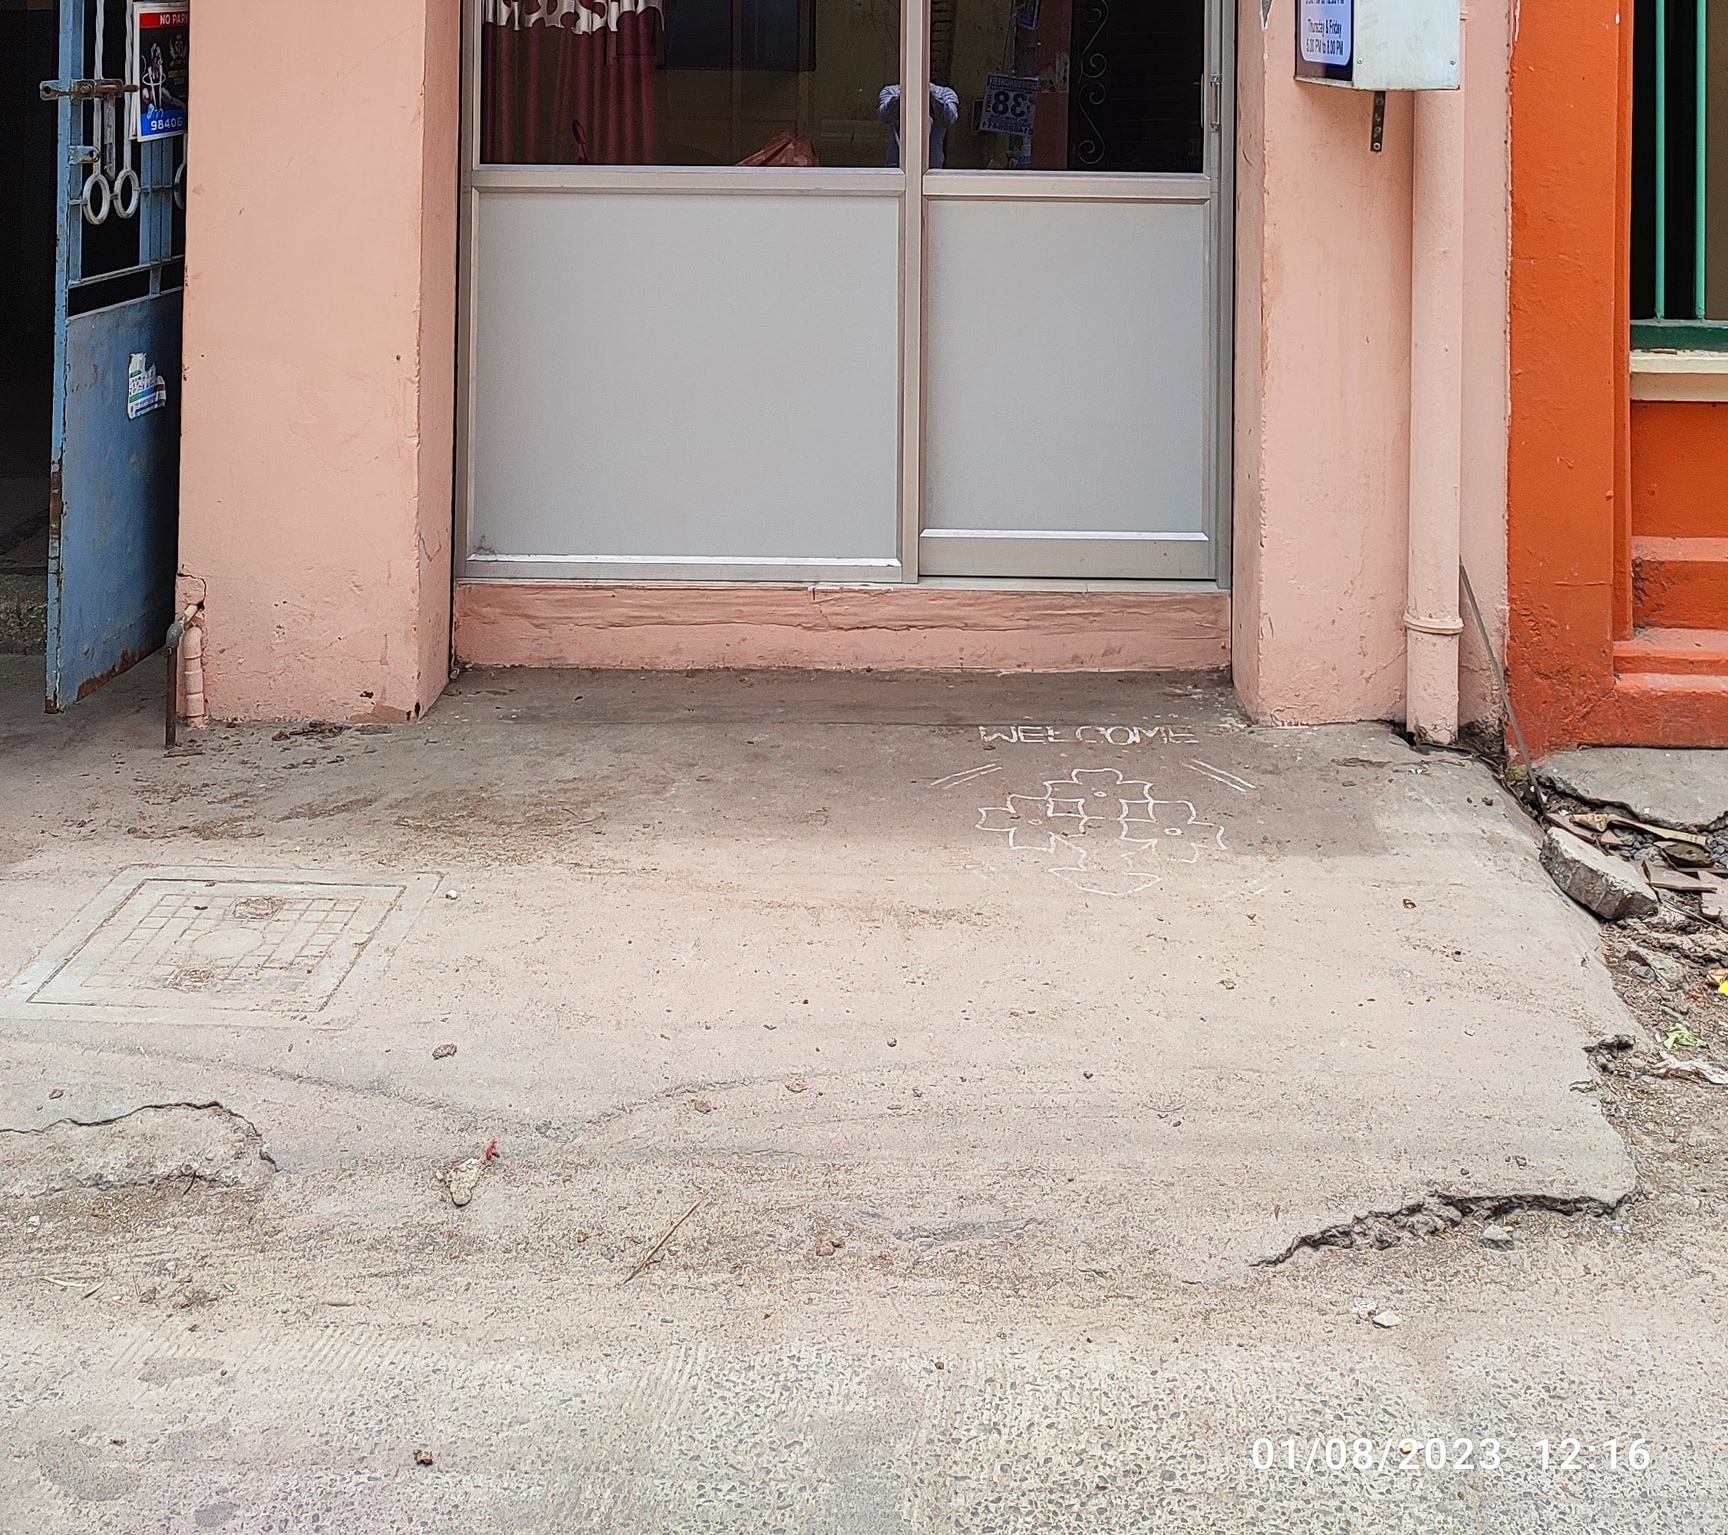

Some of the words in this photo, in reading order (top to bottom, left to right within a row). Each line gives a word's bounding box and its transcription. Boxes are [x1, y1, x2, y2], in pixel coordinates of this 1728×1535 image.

[159, 14, 171, 26] NO
[172, 13, 189, 25] PAR
[150, 116, 183, 132] 98406
[978, 725, 1199, 745] WELCOME
